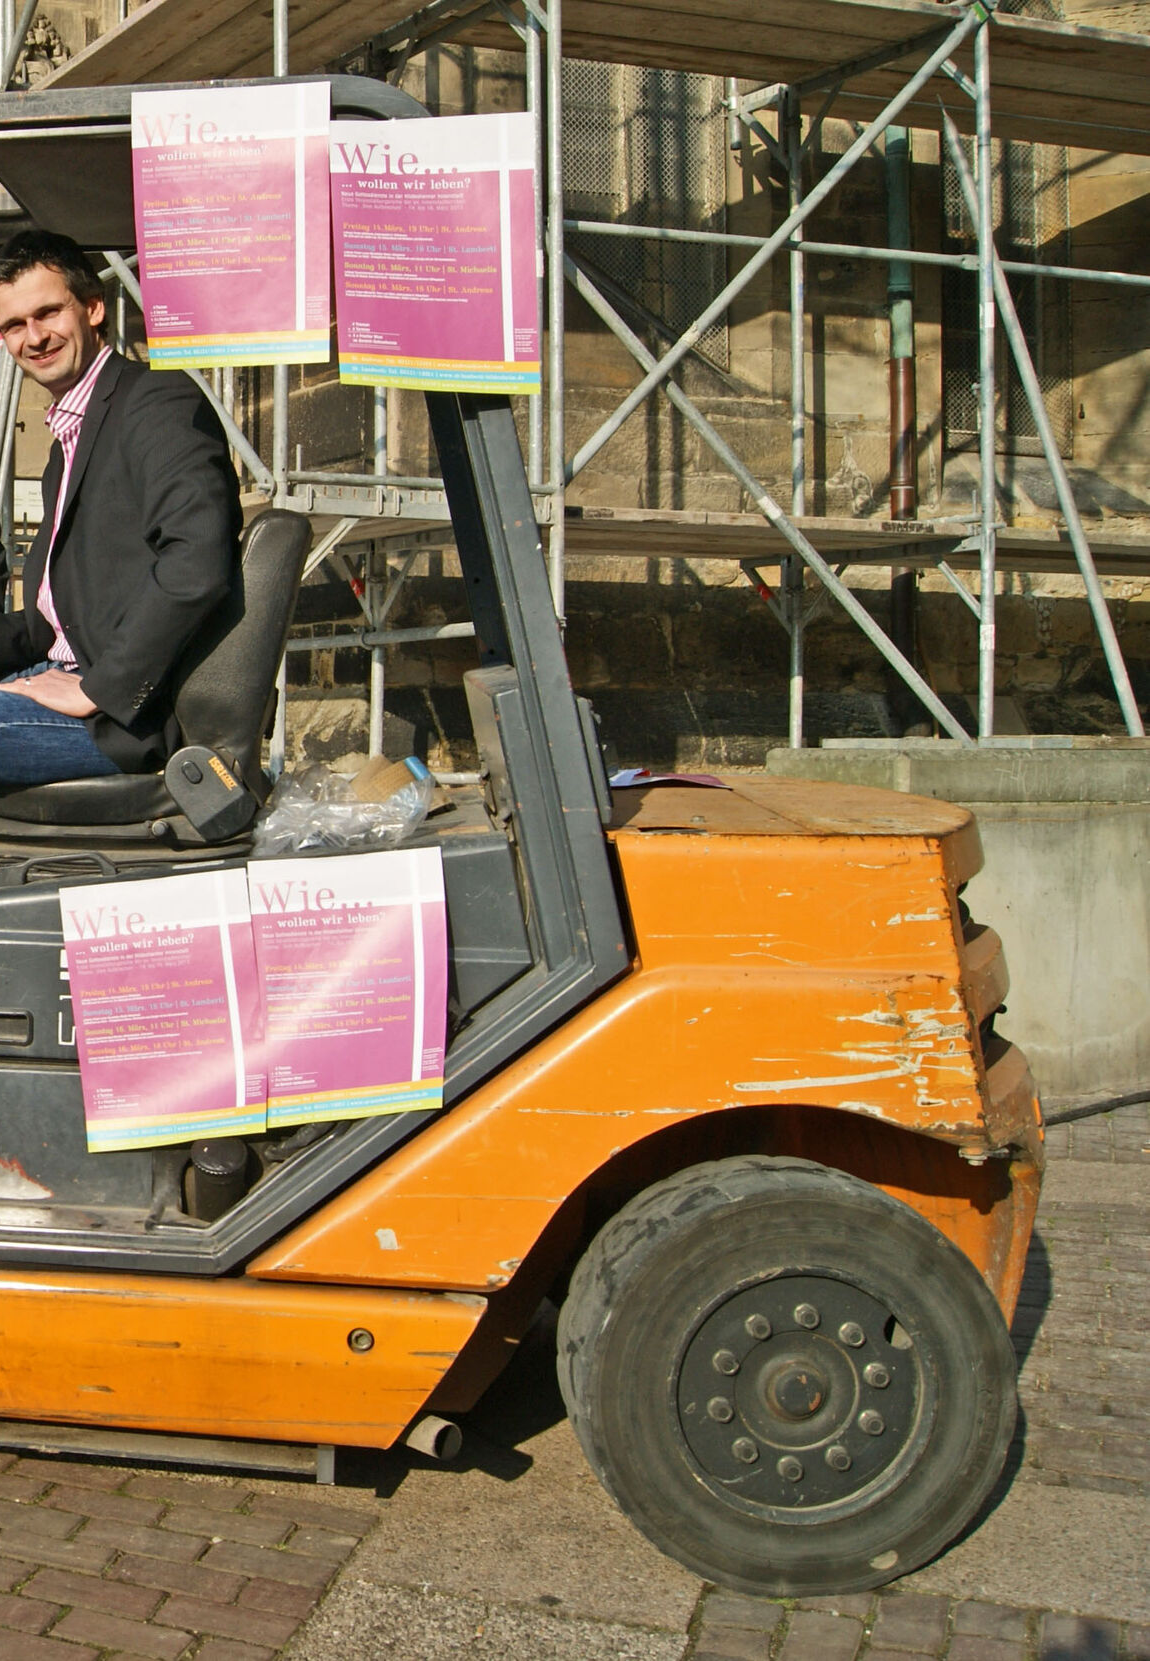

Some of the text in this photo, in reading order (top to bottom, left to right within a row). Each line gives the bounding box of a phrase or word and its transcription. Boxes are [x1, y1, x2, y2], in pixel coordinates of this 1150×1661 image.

[139, 113, 256, 147] Wie...
[157, 150, 196, 161] wollen
[202, 148, 224, 158] wir
[335, 143, 458, 175] Wie...
[357, 179, 397, 189] wollen
[403, 180, 425, 190] wir
[430, 177, 471, 189] leben?
[256, 880, 374, 913] Wie...
[67, 906, 182, 939] Wie...
[276, 917, 316, 927] wollen
[321, 914, 343, 925] wir
[89, 942, 127, 953] wollen
[132, 938, 153, 948] wir
[157, 933, 194, 946] leben?
